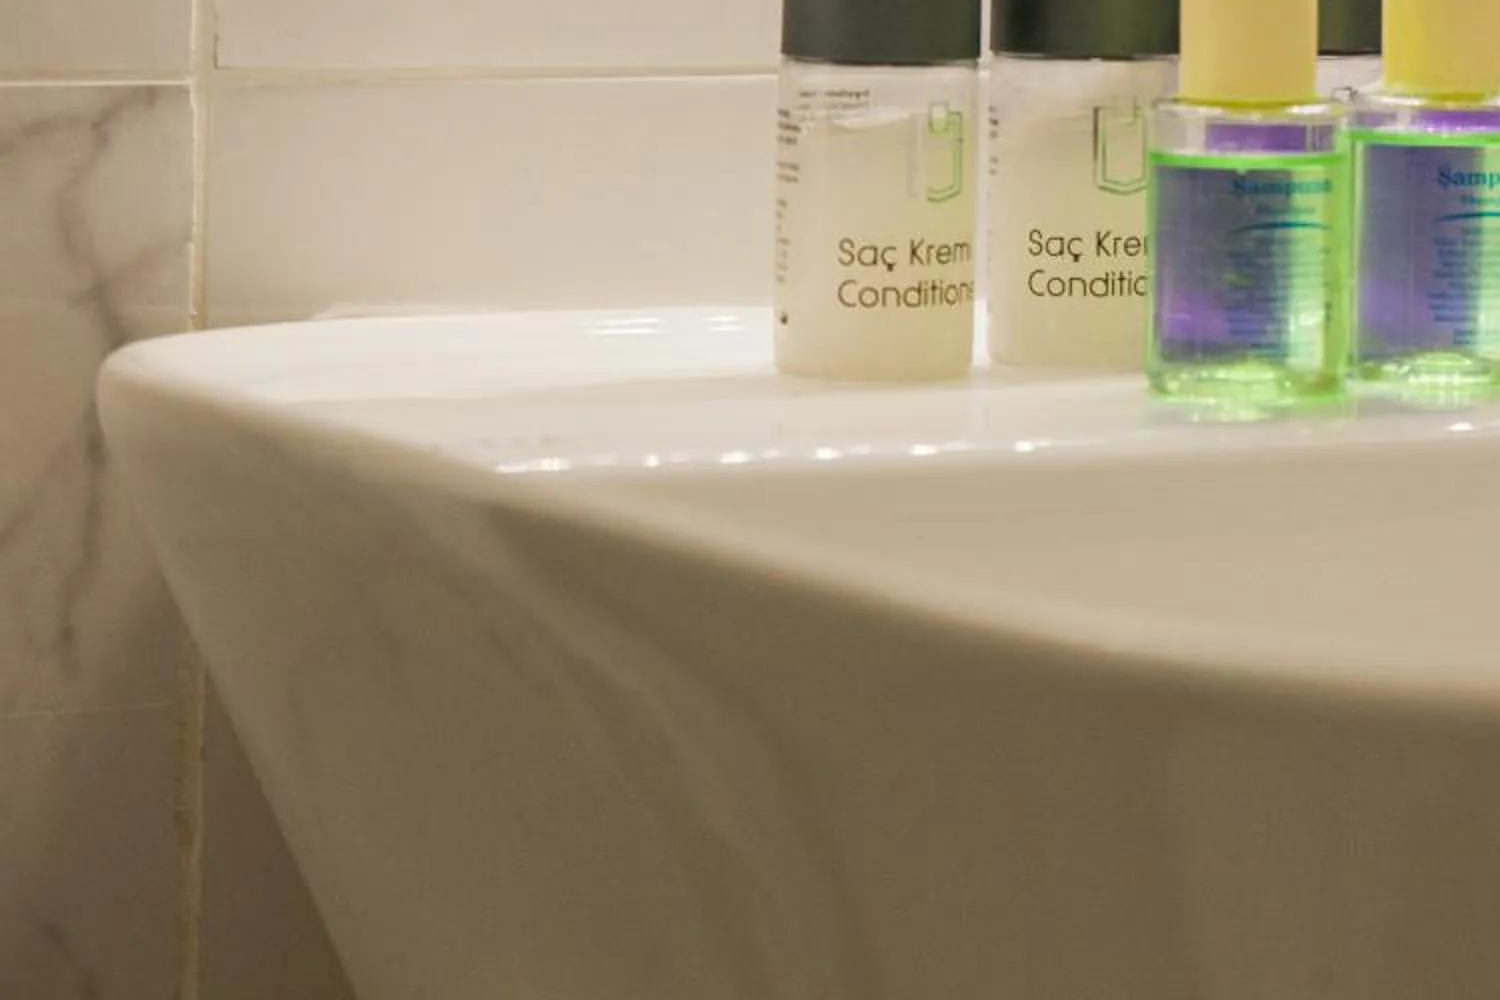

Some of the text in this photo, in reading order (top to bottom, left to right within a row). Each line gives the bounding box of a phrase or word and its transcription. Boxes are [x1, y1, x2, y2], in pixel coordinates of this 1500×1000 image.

[838, 237, 971, 272] Saç Krem
[1028, 229, 1149, 263] Saç Kre
